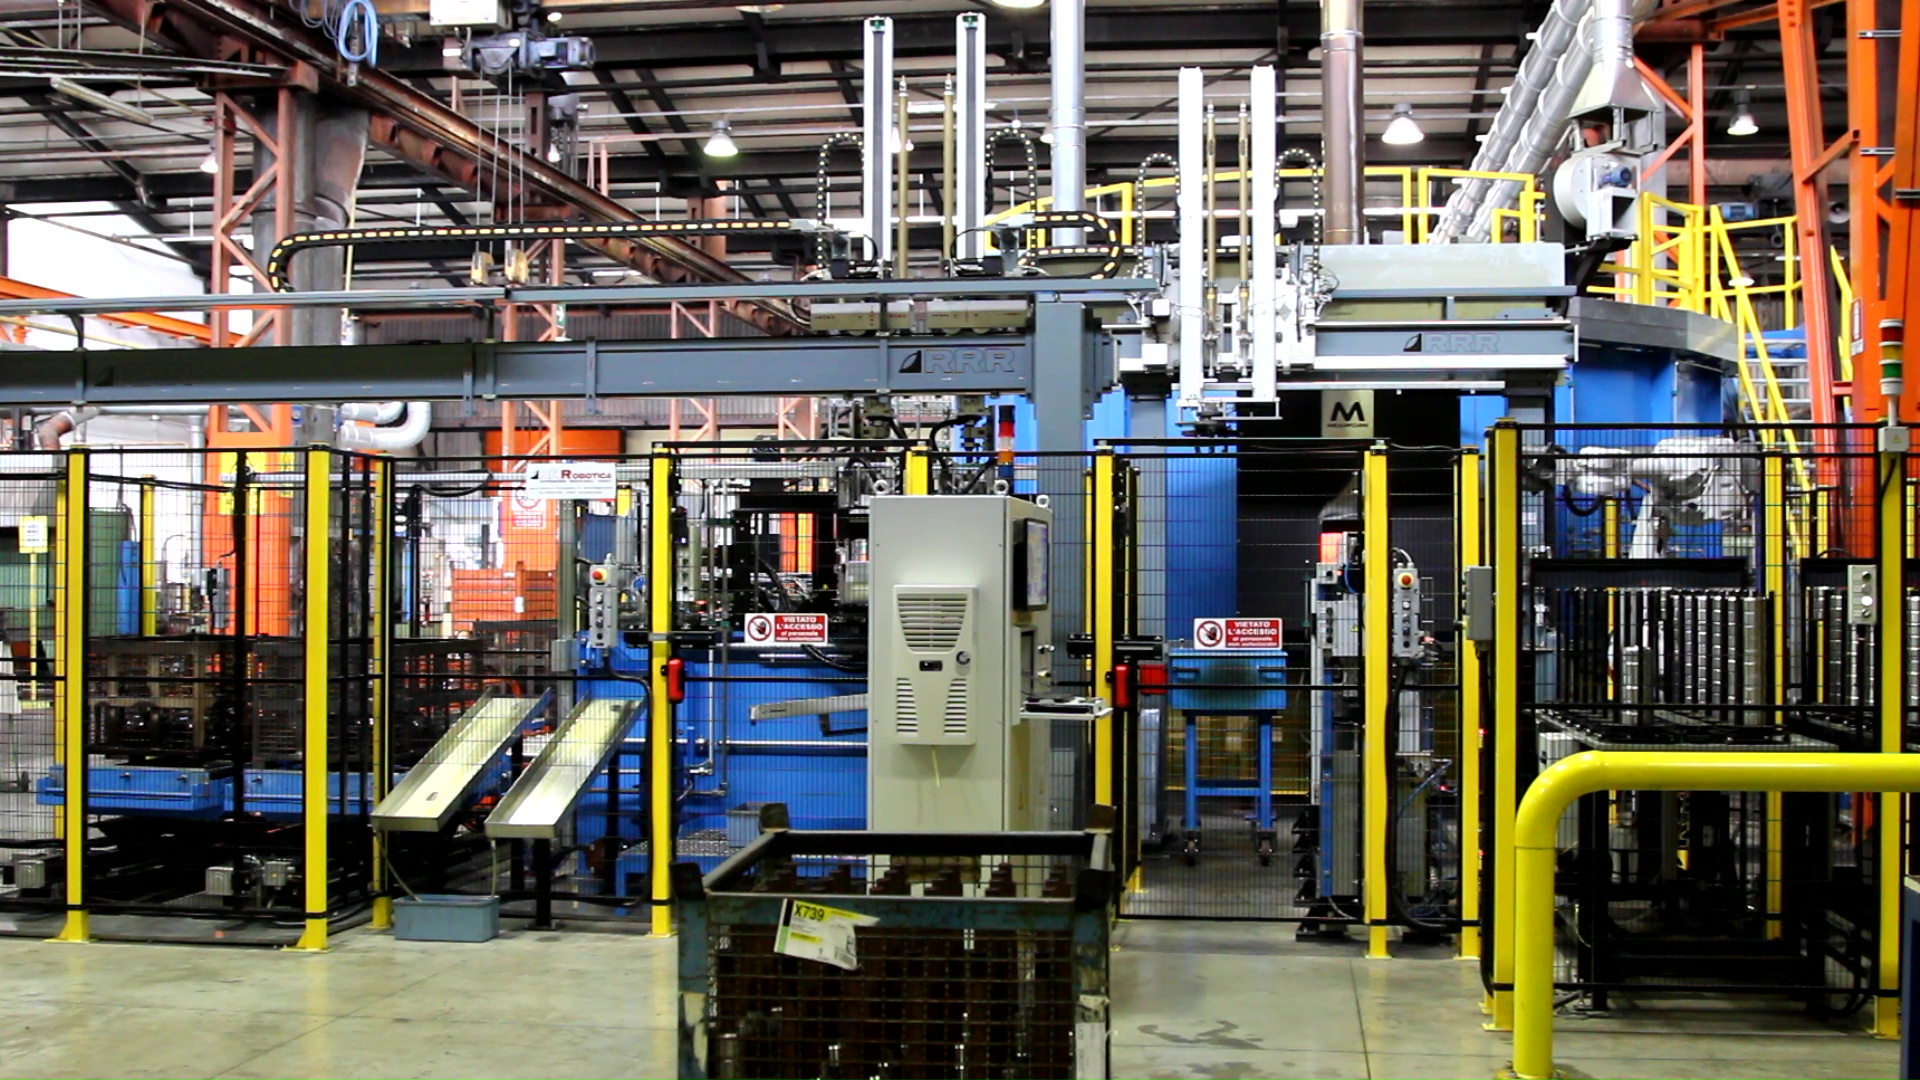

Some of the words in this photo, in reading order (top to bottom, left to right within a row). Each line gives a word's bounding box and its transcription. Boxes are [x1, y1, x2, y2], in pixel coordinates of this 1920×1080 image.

[1424, 332, 1500, 353] RRR
[923, 348, 1016, 374] RRR
[794, 903, 825, 921] X739
